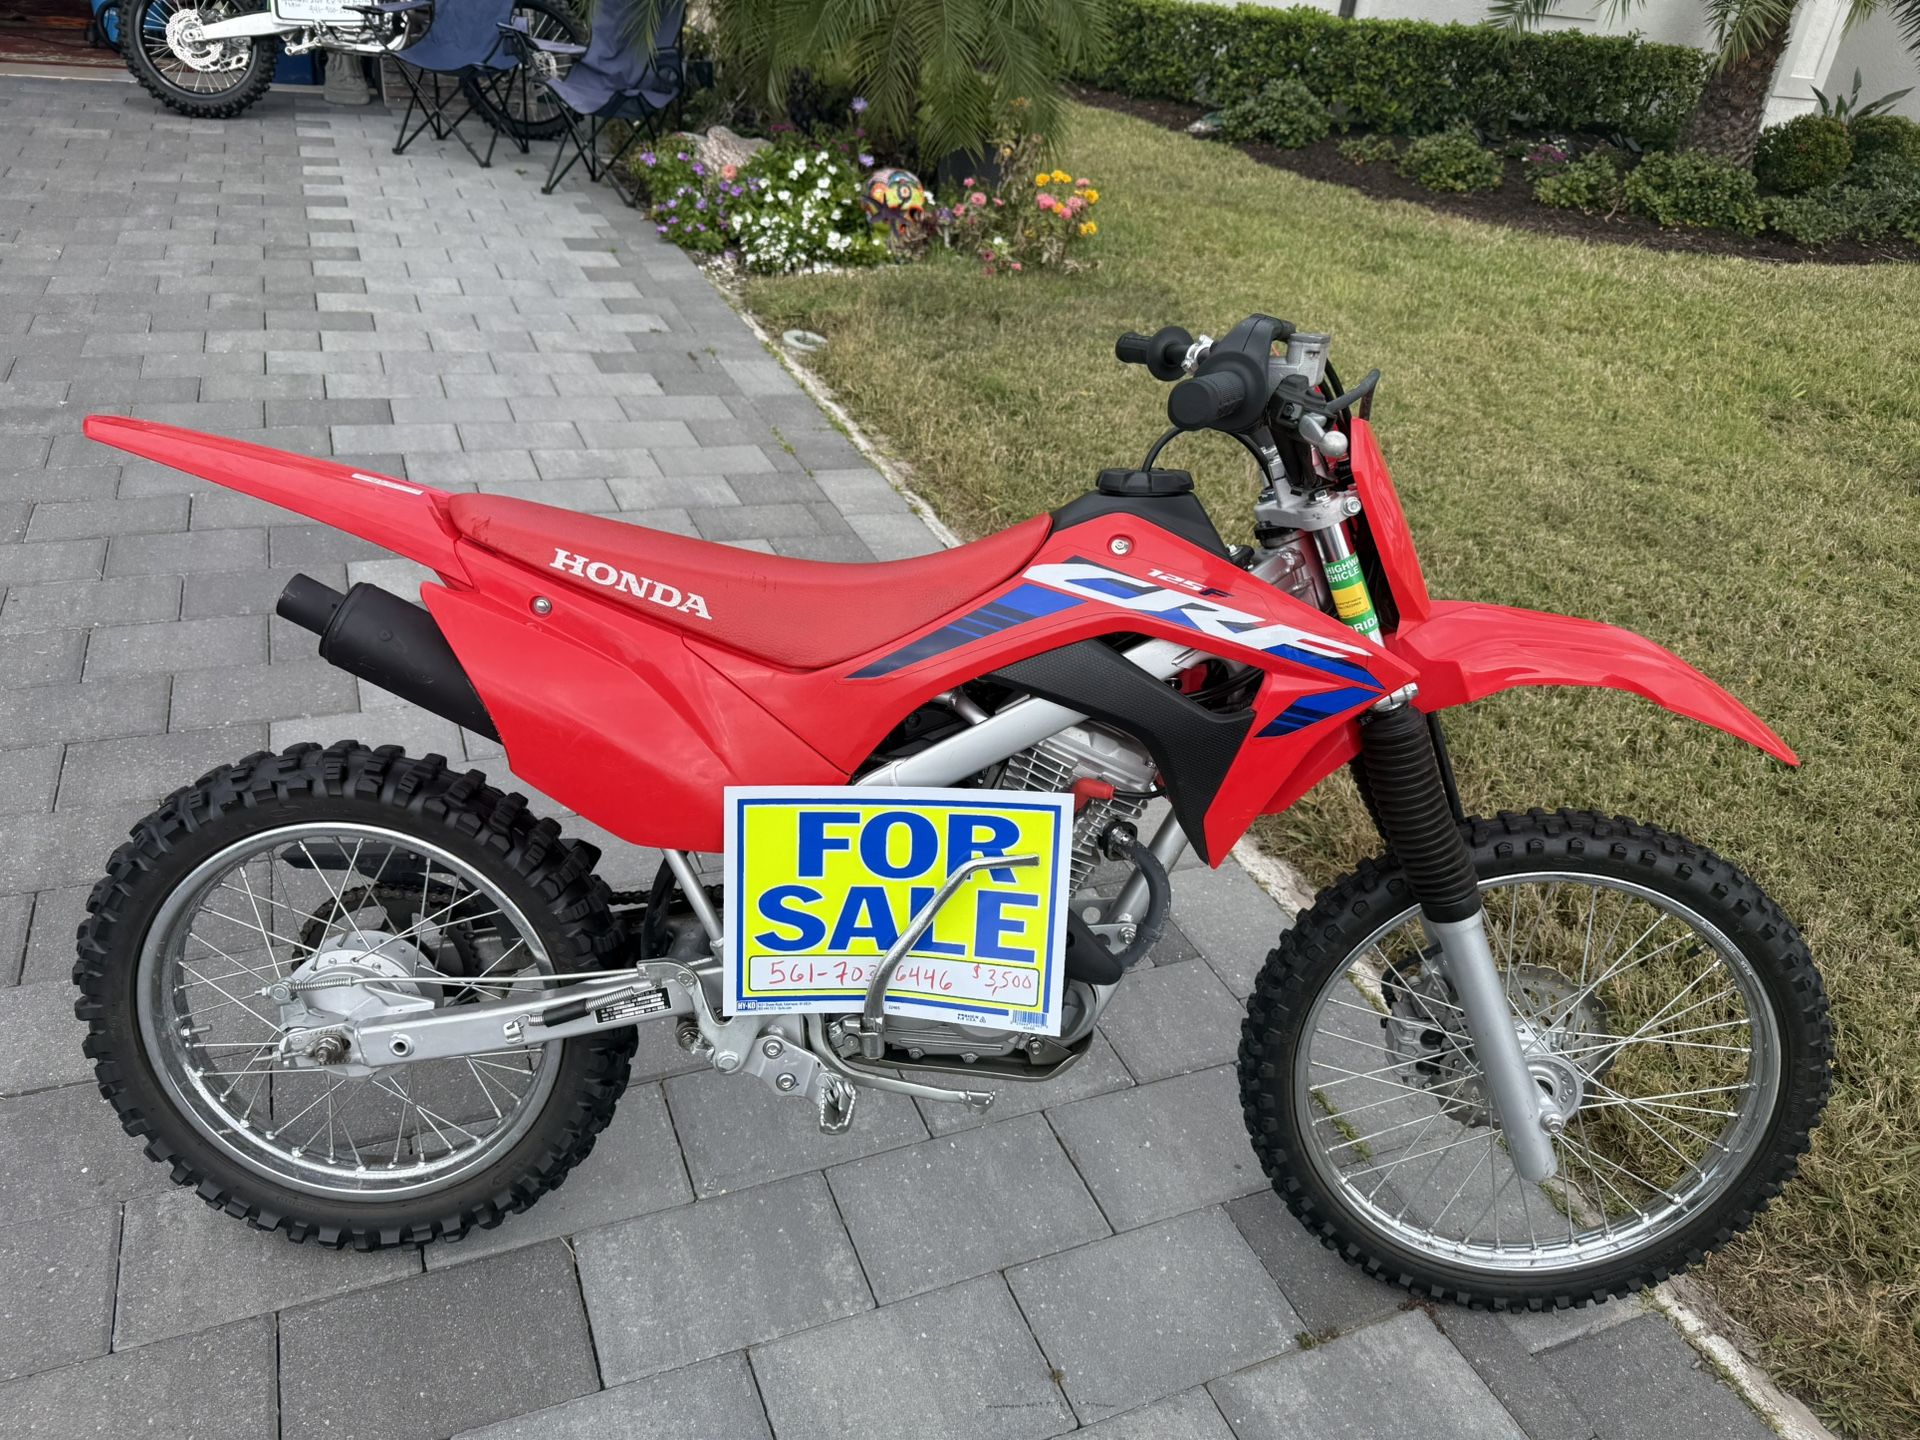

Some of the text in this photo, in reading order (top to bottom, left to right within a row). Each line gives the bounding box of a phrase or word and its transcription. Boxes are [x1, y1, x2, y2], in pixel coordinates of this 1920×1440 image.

[549, 547, 713, 620] HONDA
[1021, 563, 1374, 659] CRF
[1147, 568, 1234, 598] 125F
[797, 811, 1020, 884] FOR
[754, 885, 1039, 963] SALE
[972, 963, 1032, 997] $3,500
